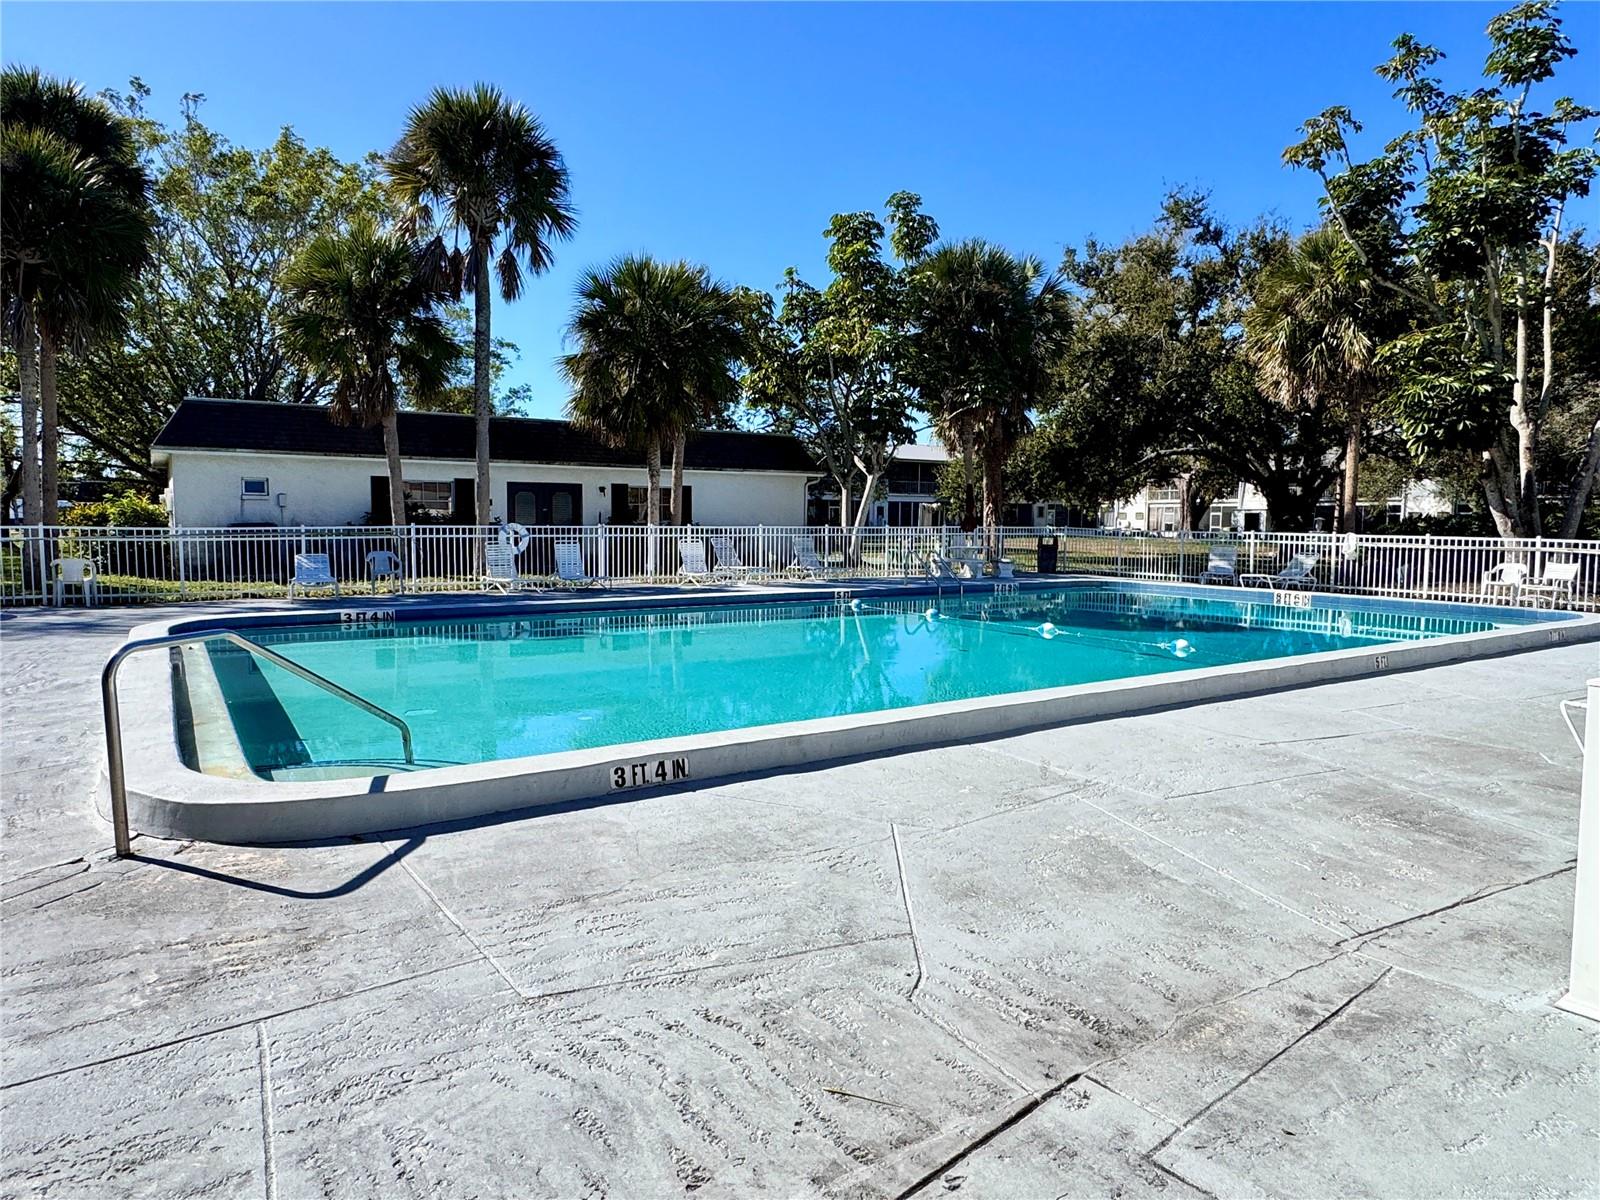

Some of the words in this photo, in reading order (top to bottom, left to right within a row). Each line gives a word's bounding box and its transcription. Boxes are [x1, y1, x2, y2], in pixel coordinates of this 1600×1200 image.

[343, 612, 352, 623] 3
[371, 611, 382, 622] 4
[383, 611, 394, 621] IN
[614, 766, 626, 788] 3
[632, 763, 650, 785] FT.
[655, 760, 667, 781] 4
[672, 758, 689, 779] IN.
